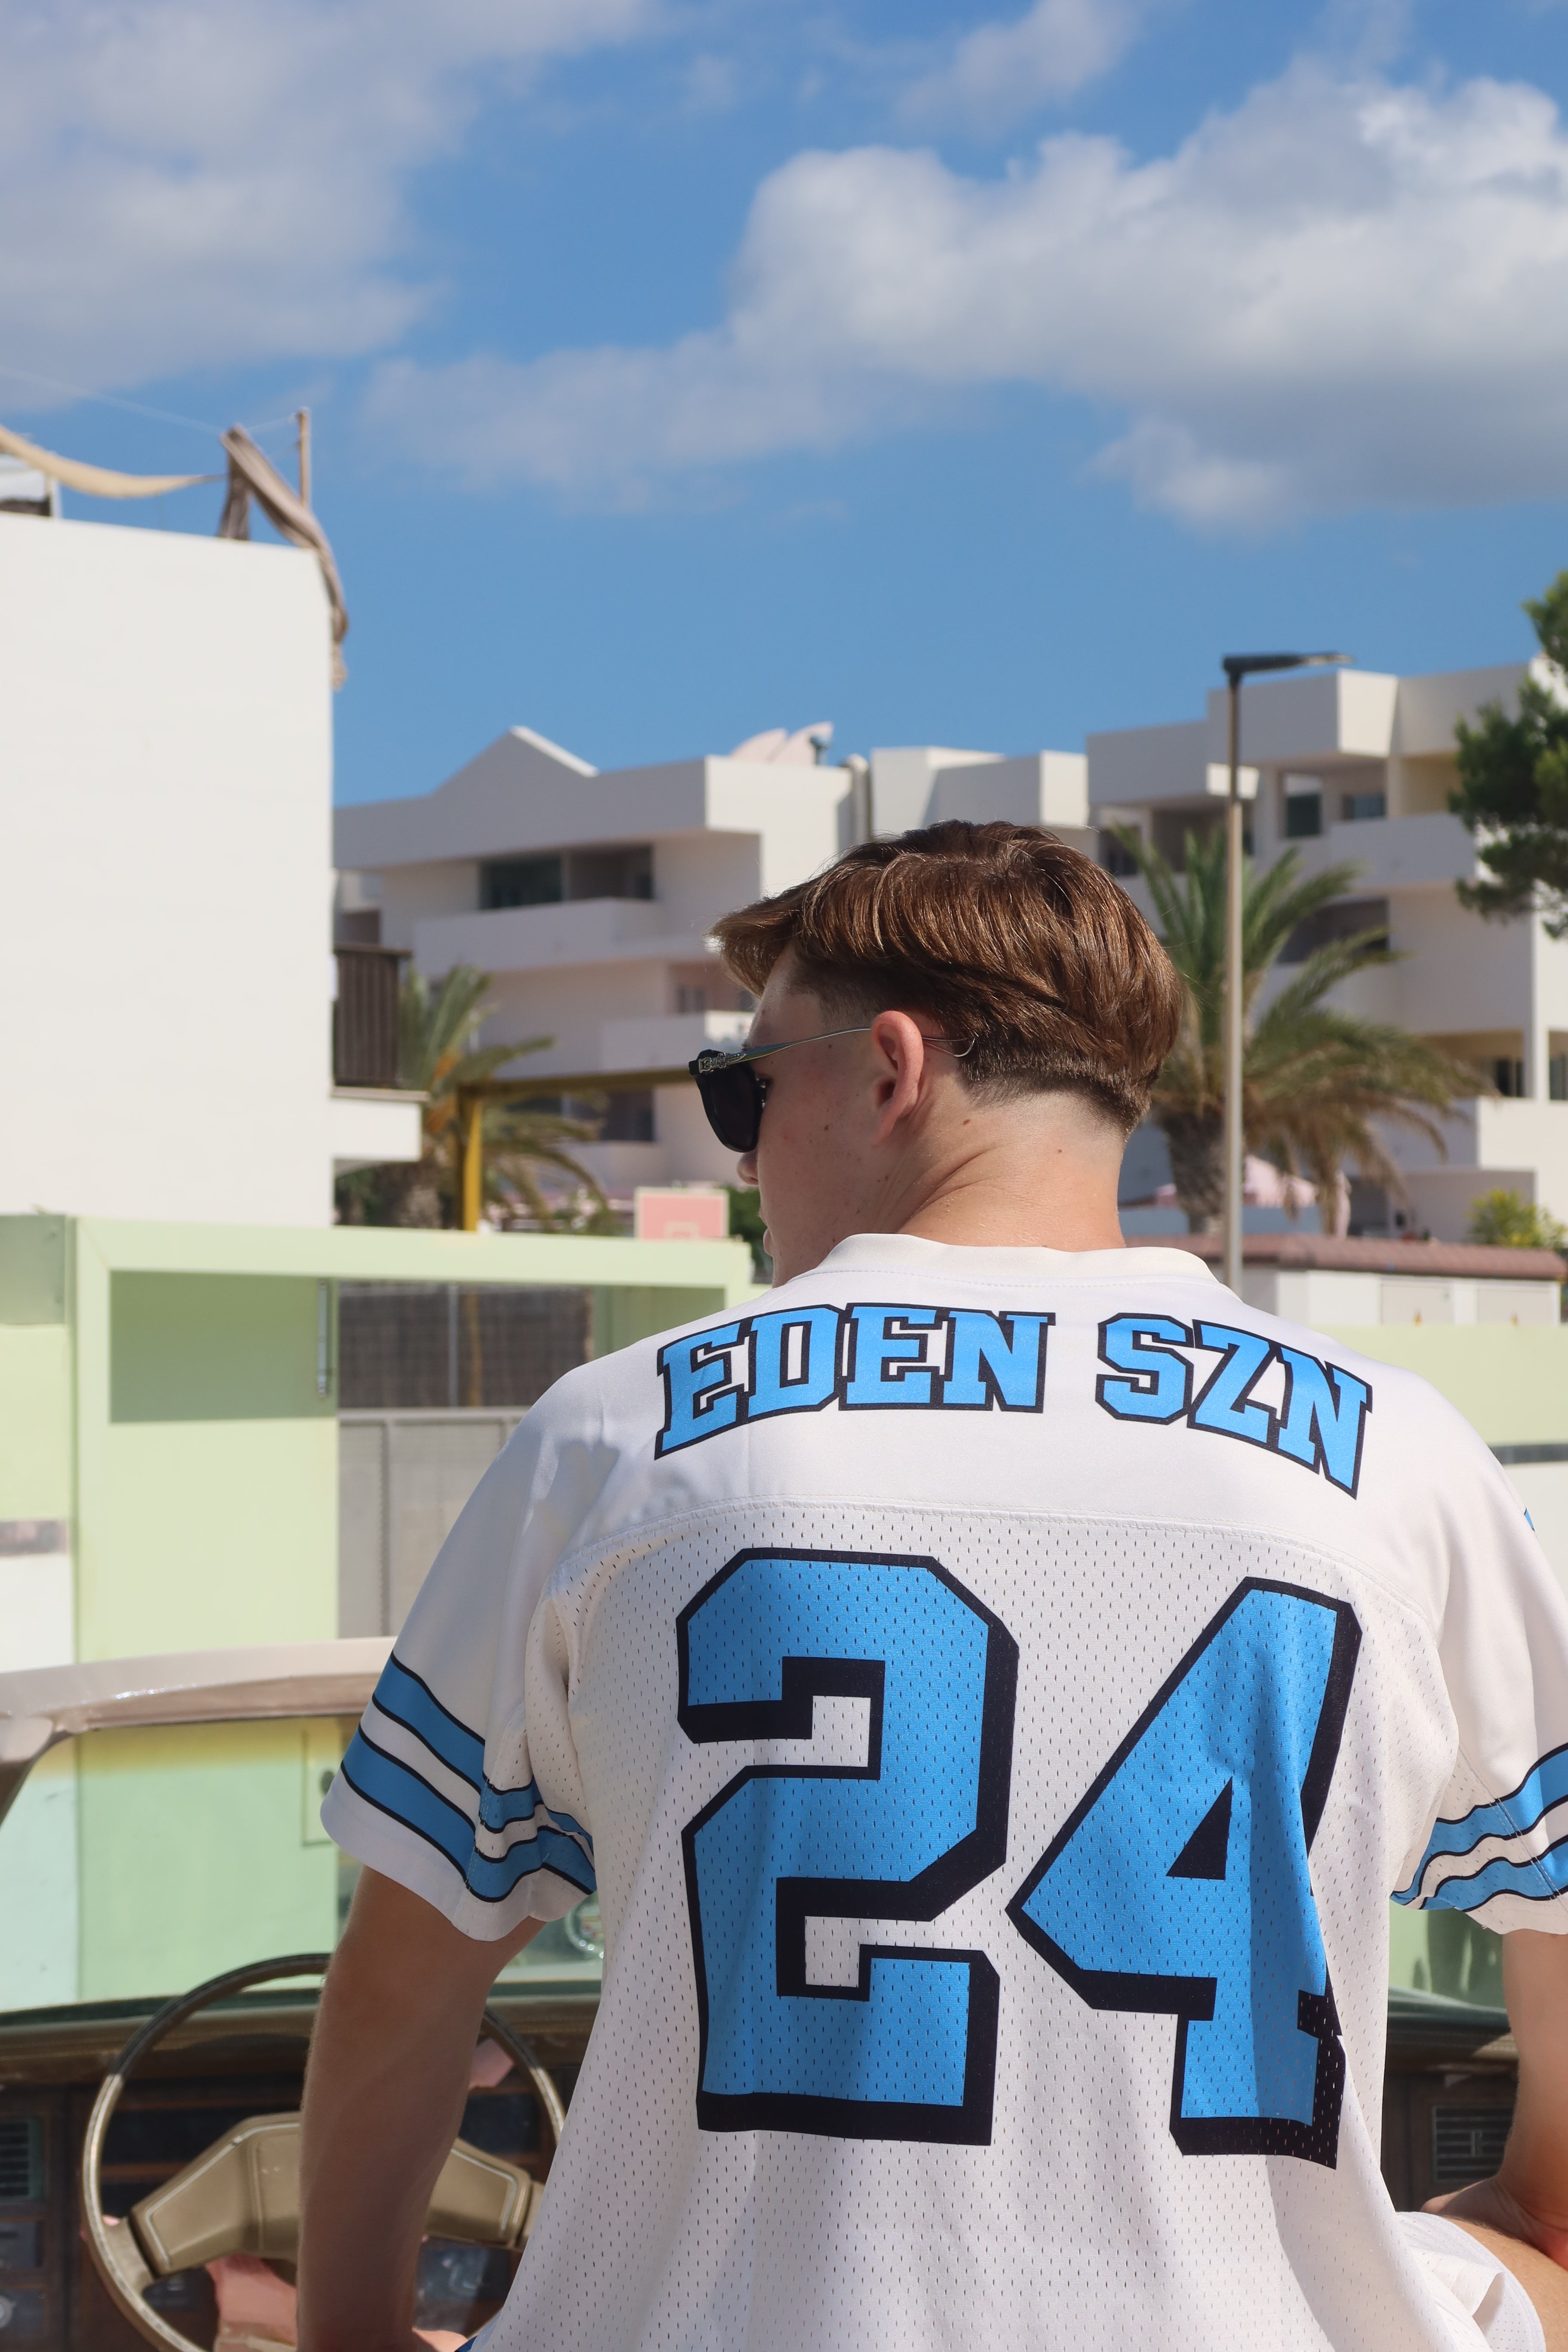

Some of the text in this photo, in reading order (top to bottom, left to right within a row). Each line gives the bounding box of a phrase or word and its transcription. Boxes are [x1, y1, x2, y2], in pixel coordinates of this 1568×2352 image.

[655, 1303, 1372, 1500] EDEN SZN
[677, 1548, 1362, 2169] 24
